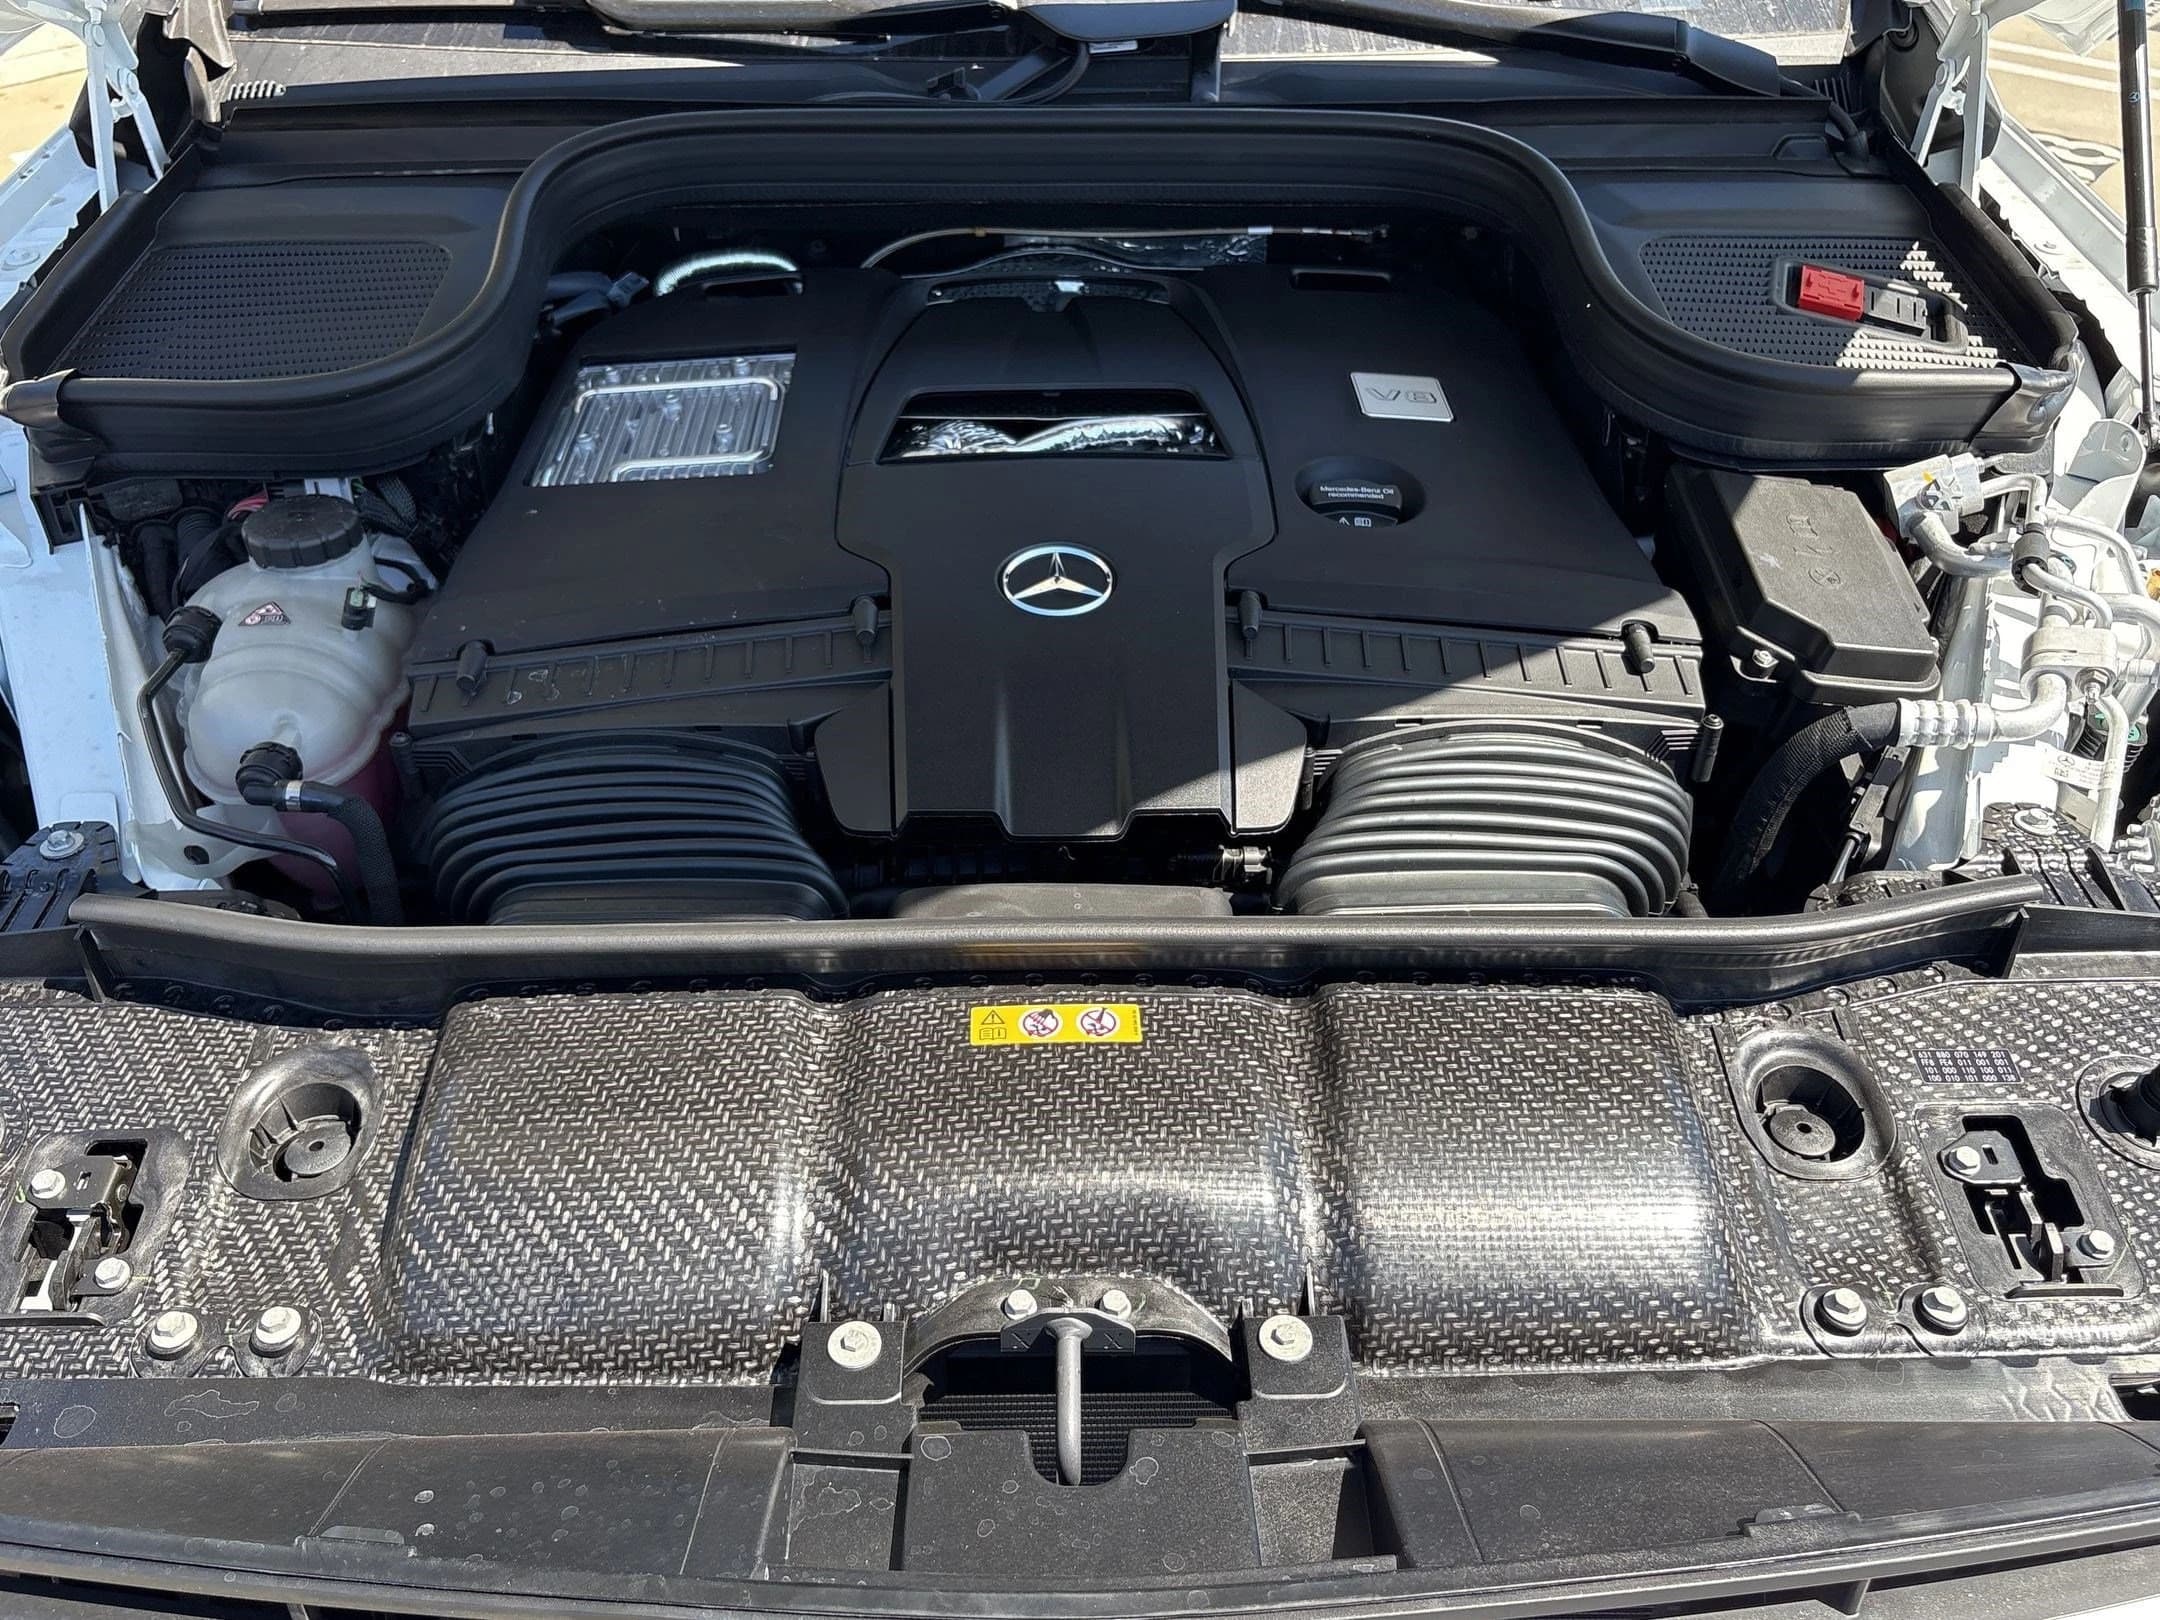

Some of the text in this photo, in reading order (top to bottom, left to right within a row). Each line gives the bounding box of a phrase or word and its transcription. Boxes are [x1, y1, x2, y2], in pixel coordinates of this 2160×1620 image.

[1364, 387, 1437, 404] V8
[1320, 486, 1395, 495] Mercedes-Benz Oil
[1328, 492, 1384, 500] recommended
[1928, 1074, 1942, 1082] 100
[1945, 1074, 1960, 1082] 010
[1964, 1074, 1978, 1082] 101
[1982, 1074, 1997, 1082] 000
